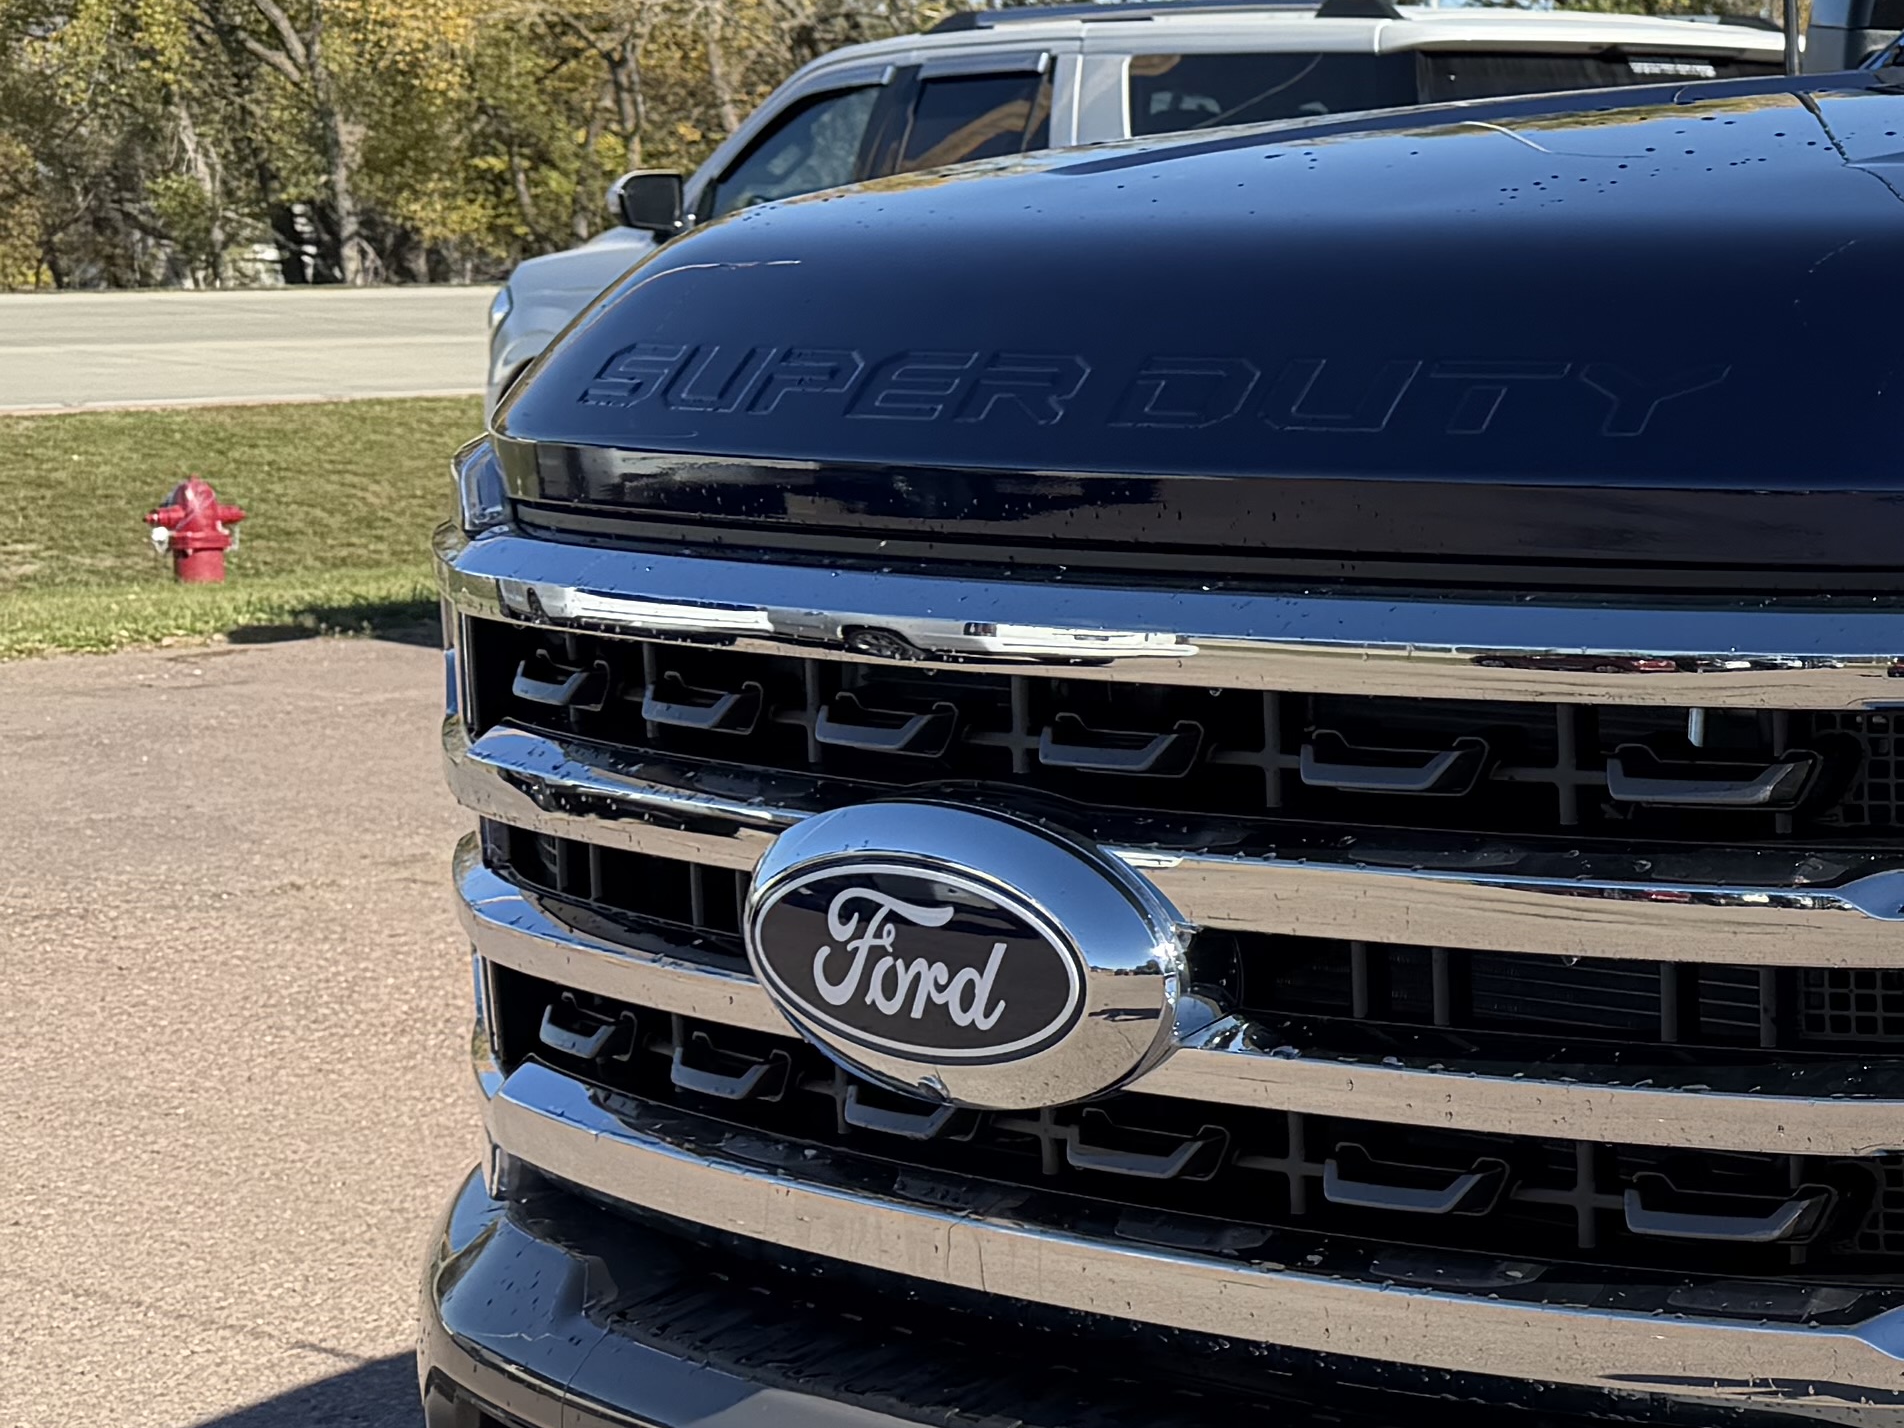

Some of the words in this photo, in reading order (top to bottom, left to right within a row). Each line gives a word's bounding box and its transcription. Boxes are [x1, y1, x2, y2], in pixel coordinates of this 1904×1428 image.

[577, 343, 1092, 426] SUPER
[1107, 357, 1732, 436] DUTY
[813, 888, 1007, 1031] Ford
